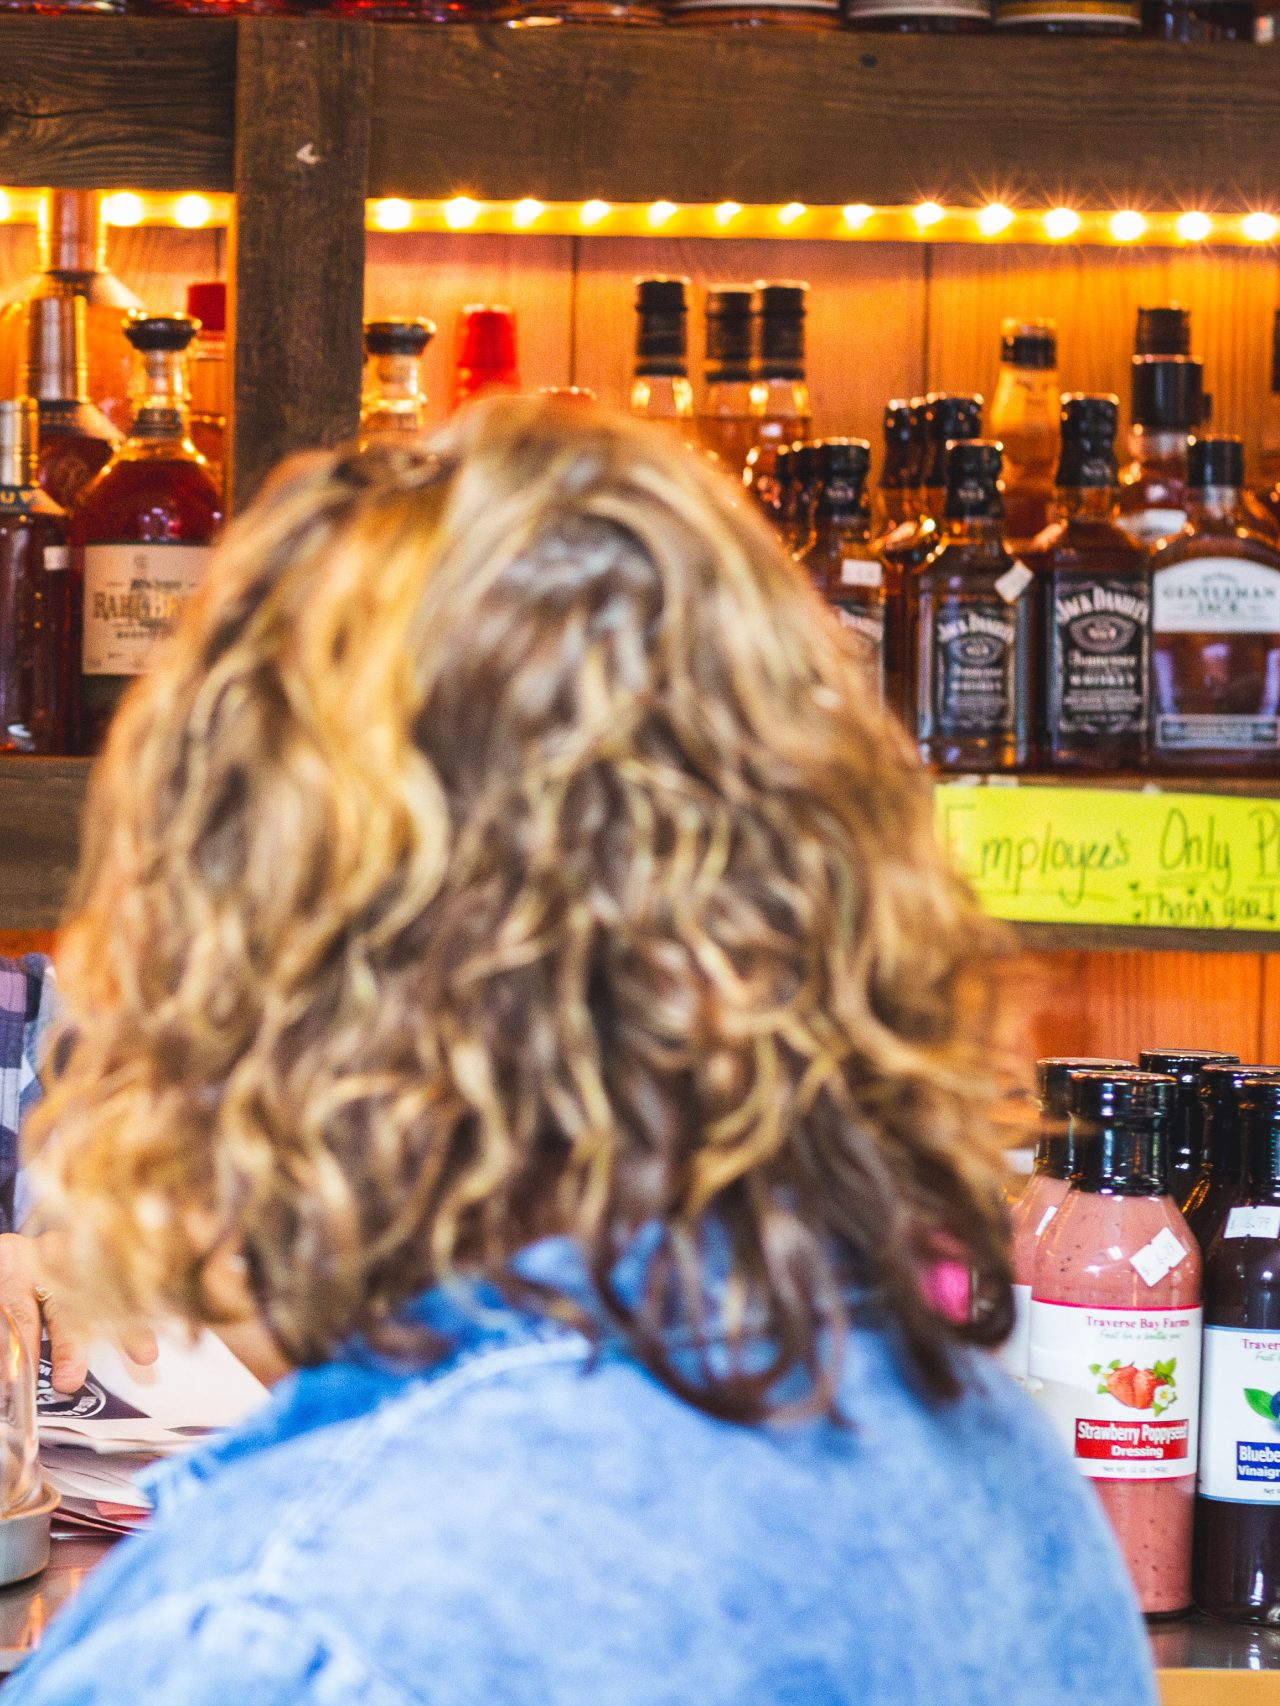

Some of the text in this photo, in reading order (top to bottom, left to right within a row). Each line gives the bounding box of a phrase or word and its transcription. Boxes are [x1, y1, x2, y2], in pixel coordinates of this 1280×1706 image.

[1160, 807, 1232, 896] Only
[1086, 1315, 1137, 1329] Traverse
[1139, 1318, 1161, 1331] Bay
[1078, 1421, 1188, 1446] Strawberry Poppyseed
[1111, 1444, 1164, 1458] Dressing
